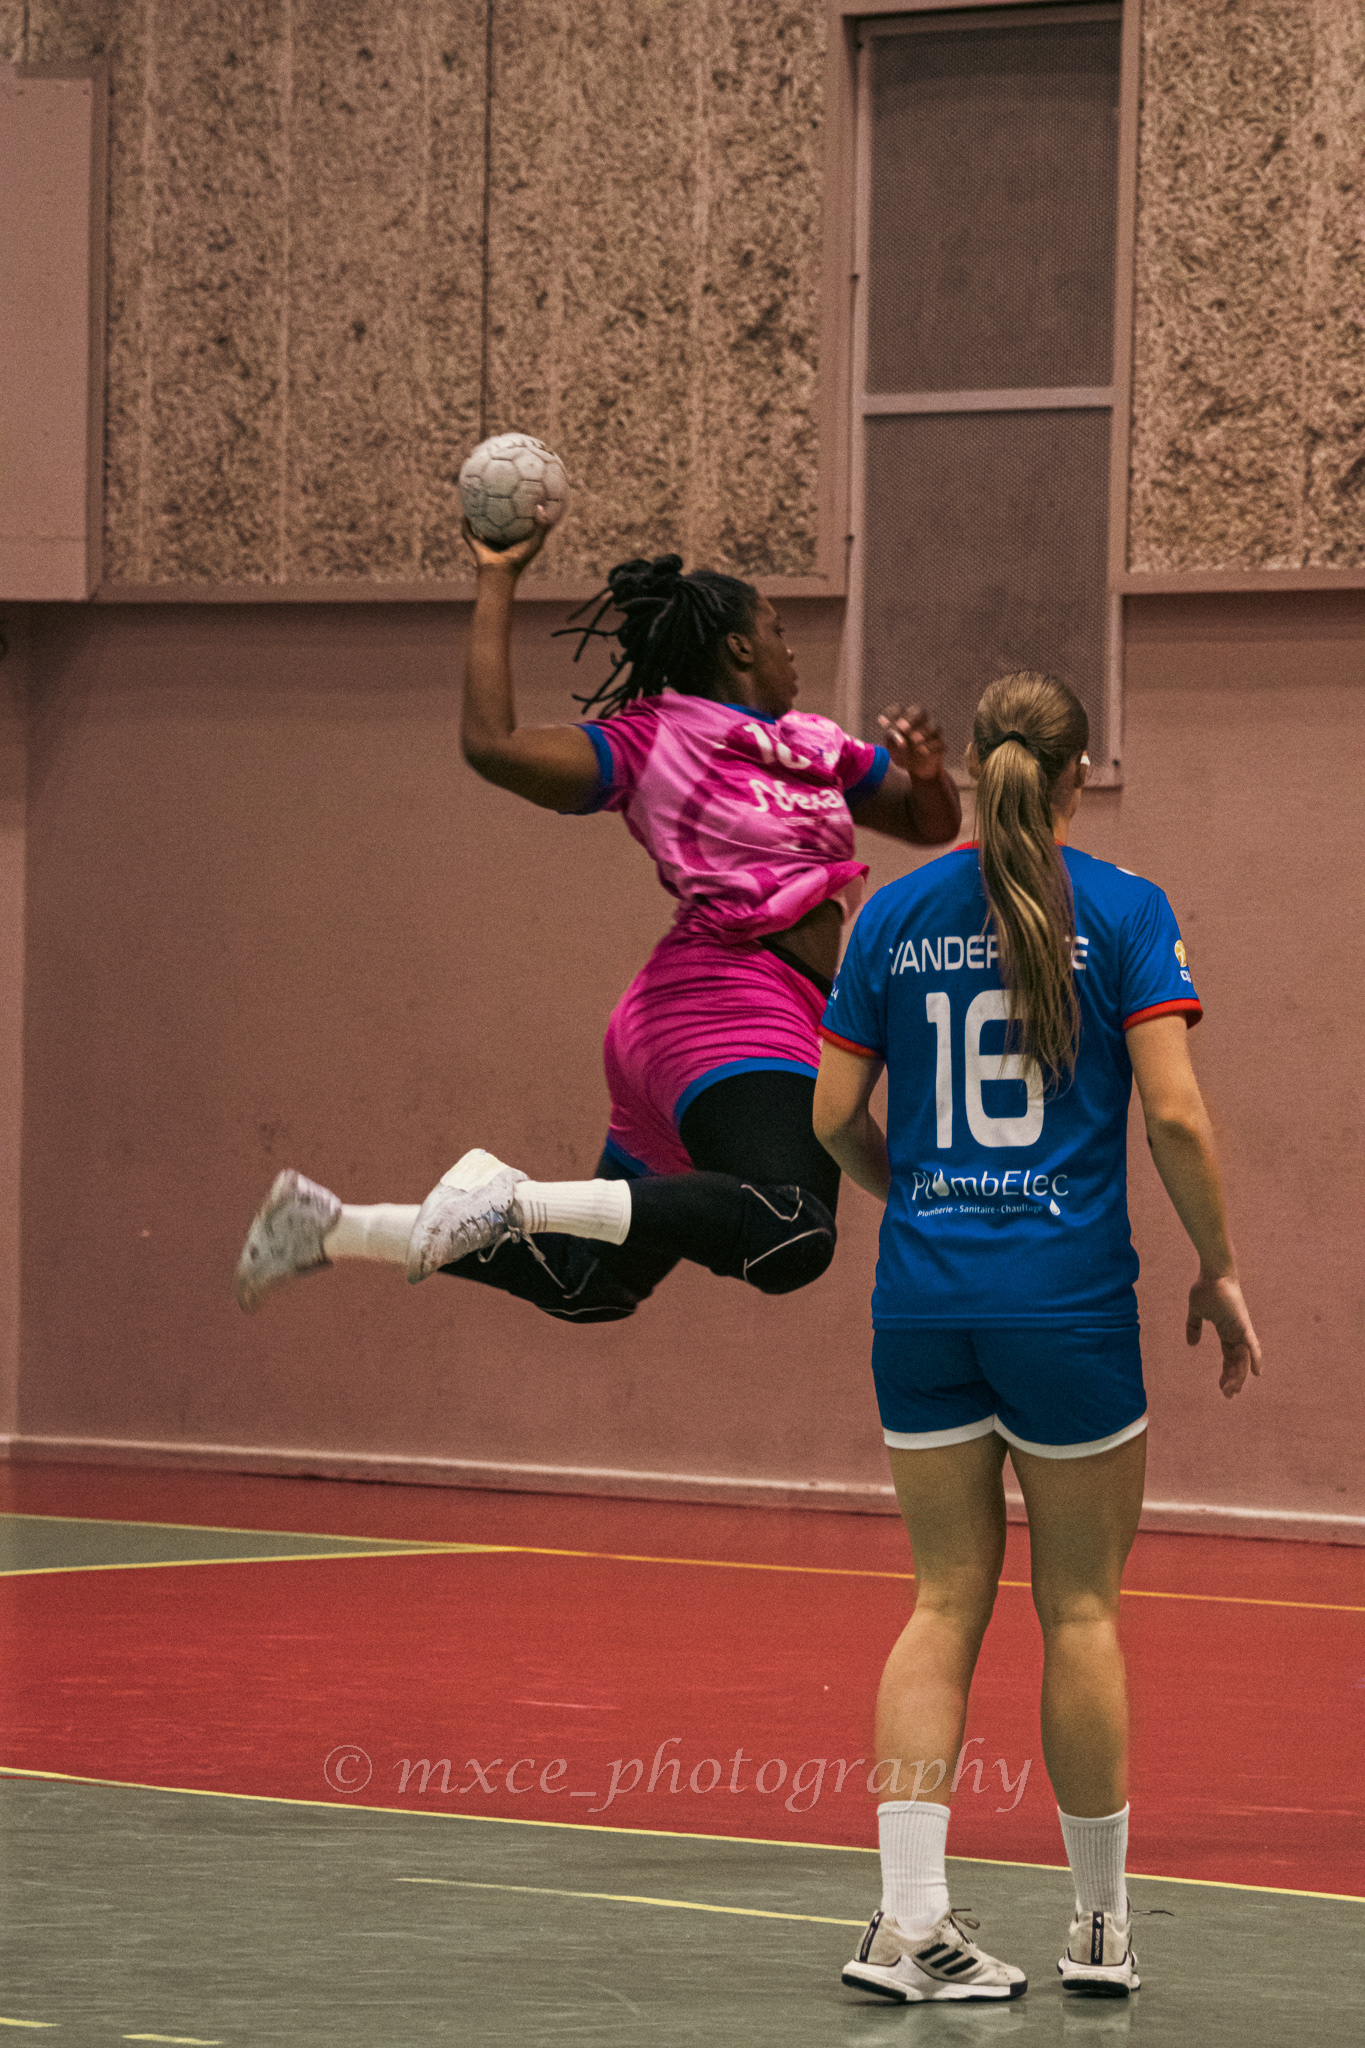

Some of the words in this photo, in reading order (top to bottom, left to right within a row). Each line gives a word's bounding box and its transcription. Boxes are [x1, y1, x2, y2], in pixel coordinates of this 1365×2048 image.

[925, 990, 1045, 1149] 16
[917, 1206, 953, 1217] Plomberie
[959, 1204, 995, 1214] Sanitaire
